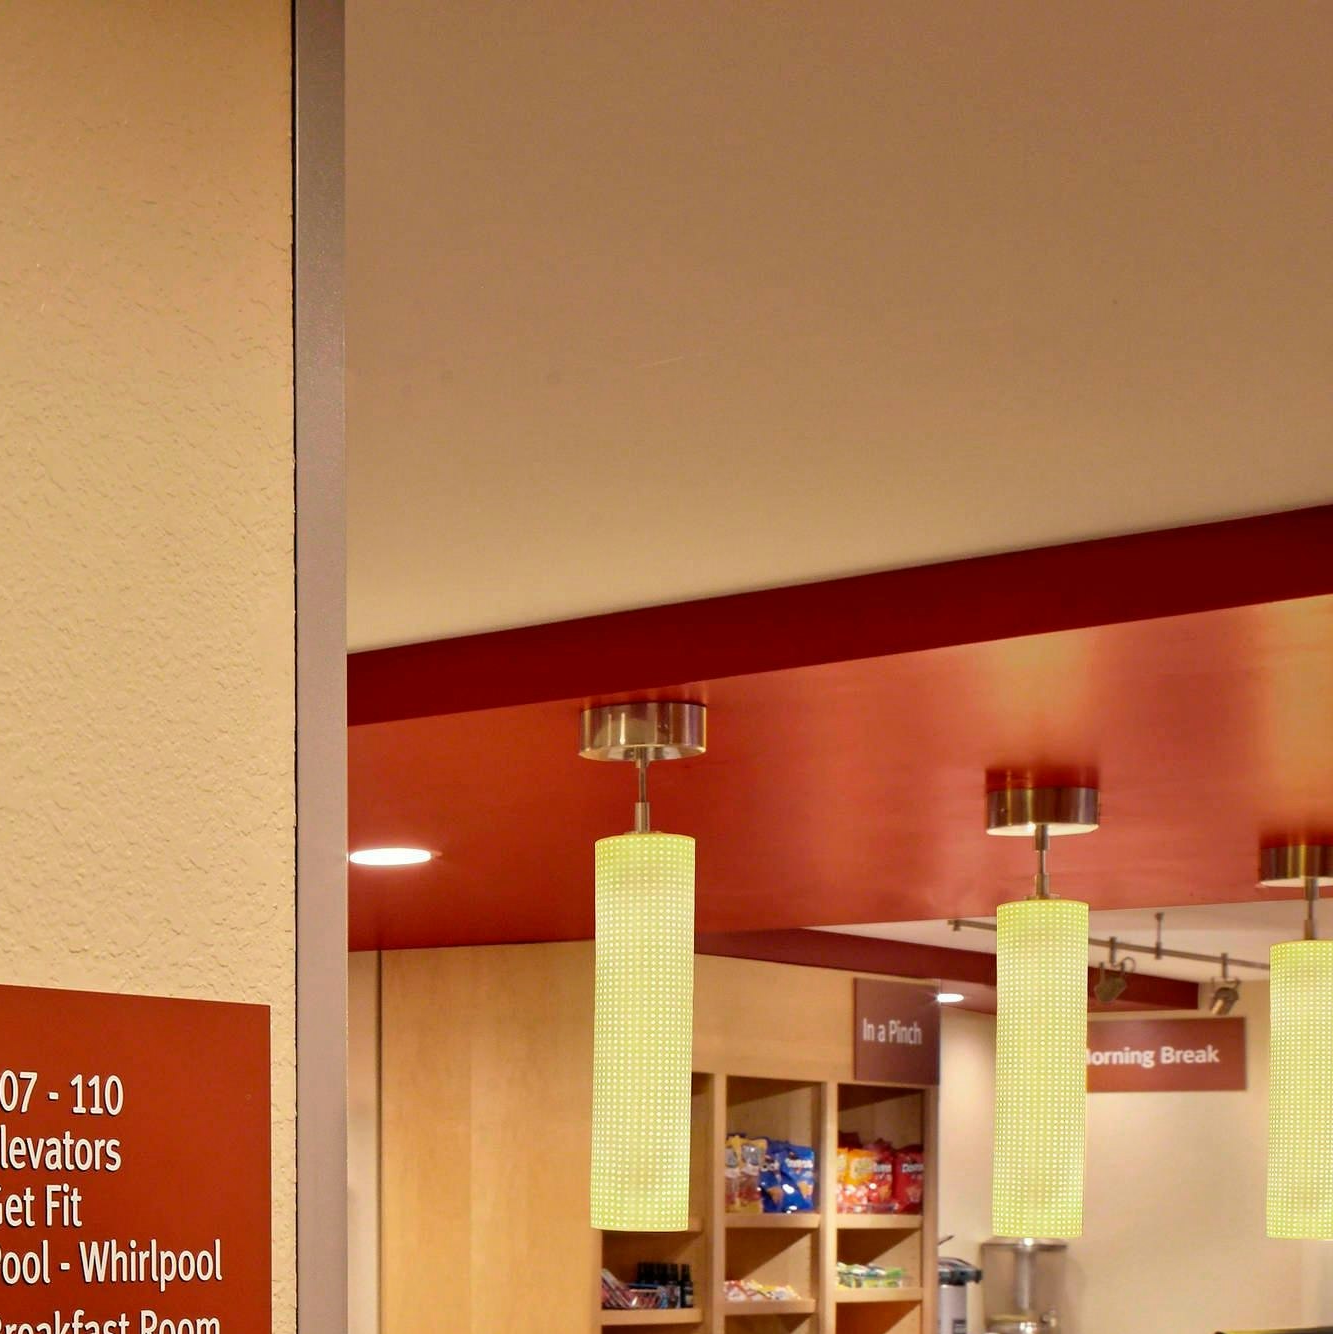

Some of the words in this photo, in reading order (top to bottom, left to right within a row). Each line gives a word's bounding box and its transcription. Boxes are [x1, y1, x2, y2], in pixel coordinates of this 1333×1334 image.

[863, 1017, 875, 1041] In
[877, 1023, 886, 1043] a
[888, 1019, 923, 1045] Pinch
[1160, 1044, 1220, 1064] Break
[71, 1075, 123, 1115] 110
[47, 1184, 82, 1226] Fit
[80, 1239, 222, 1291] Whirlpool
